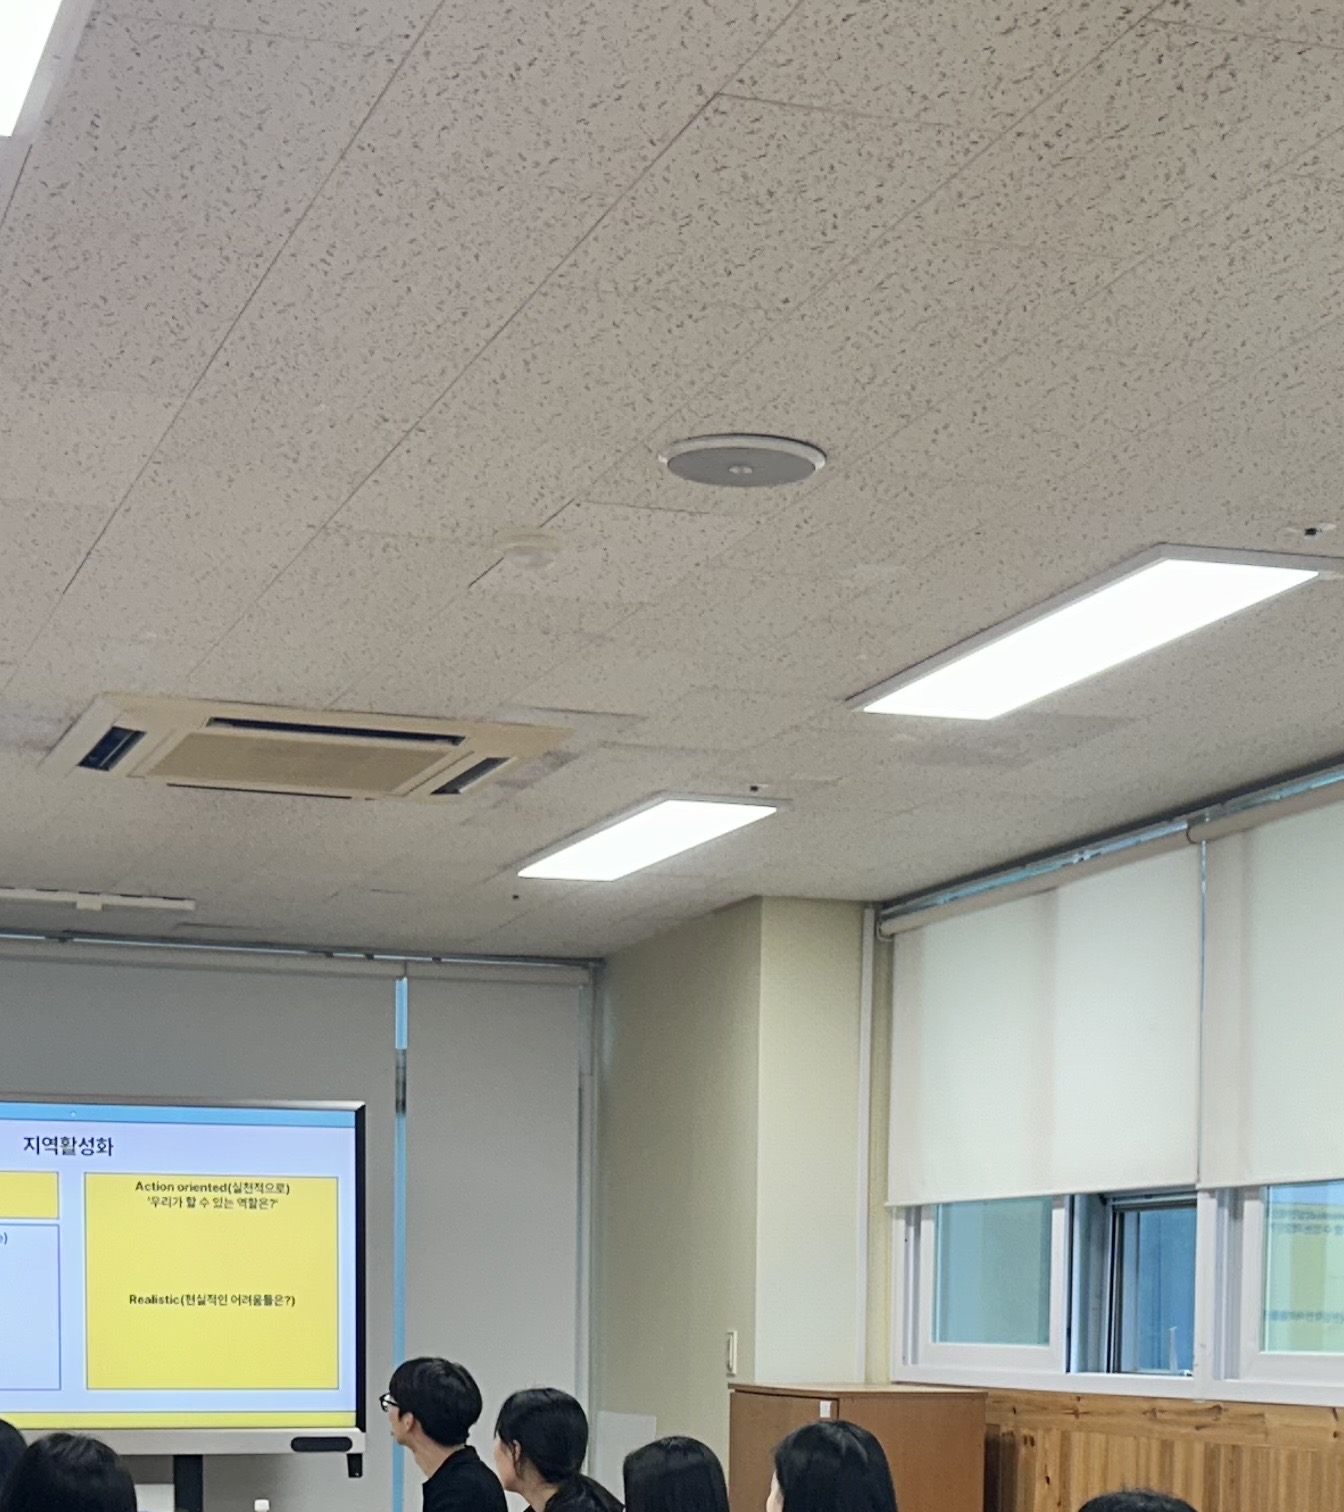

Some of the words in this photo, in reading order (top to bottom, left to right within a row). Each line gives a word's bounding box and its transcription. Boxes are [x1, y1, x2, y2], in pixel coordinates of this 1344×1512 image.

[23, 1135, 114, 1157] 지역활성화
[135, 1180, 175, 1193] Action
[186, 1196, 197, 1209] 할
[199, 1196, 211, 1209] 수
[212, 1197, 235, 1210] 있는
